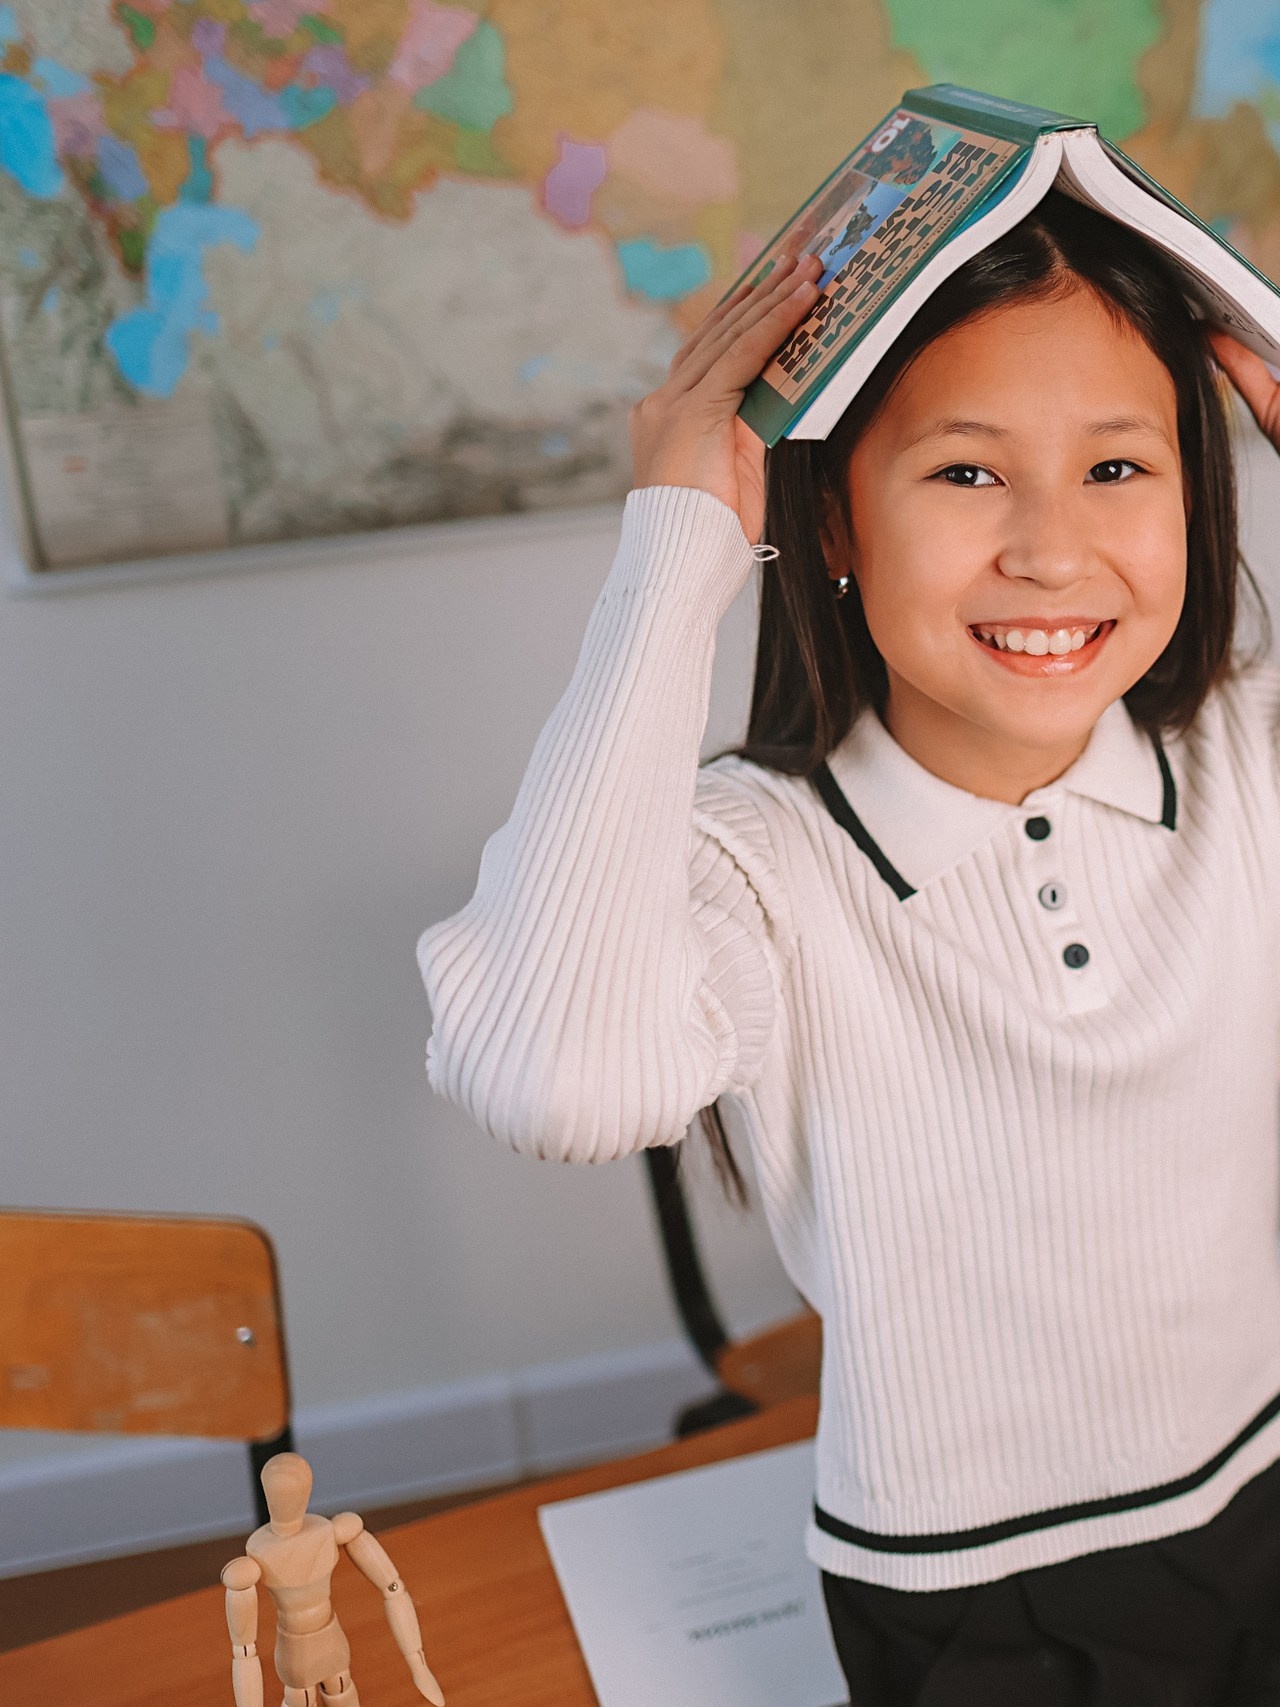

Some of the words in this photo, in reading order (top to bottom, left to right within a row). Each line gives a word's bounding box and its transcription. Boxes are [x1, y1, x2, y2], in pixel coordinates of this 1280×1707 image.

[871, 118, 909, 152] 10
[931, 140, 967, 175] И
[775, 143, 977, 367] РОССИИ
[780, 146, 987, 374] ИСТОРИЯ
[789, 151, 999, 383] ИСТОРИЯ
